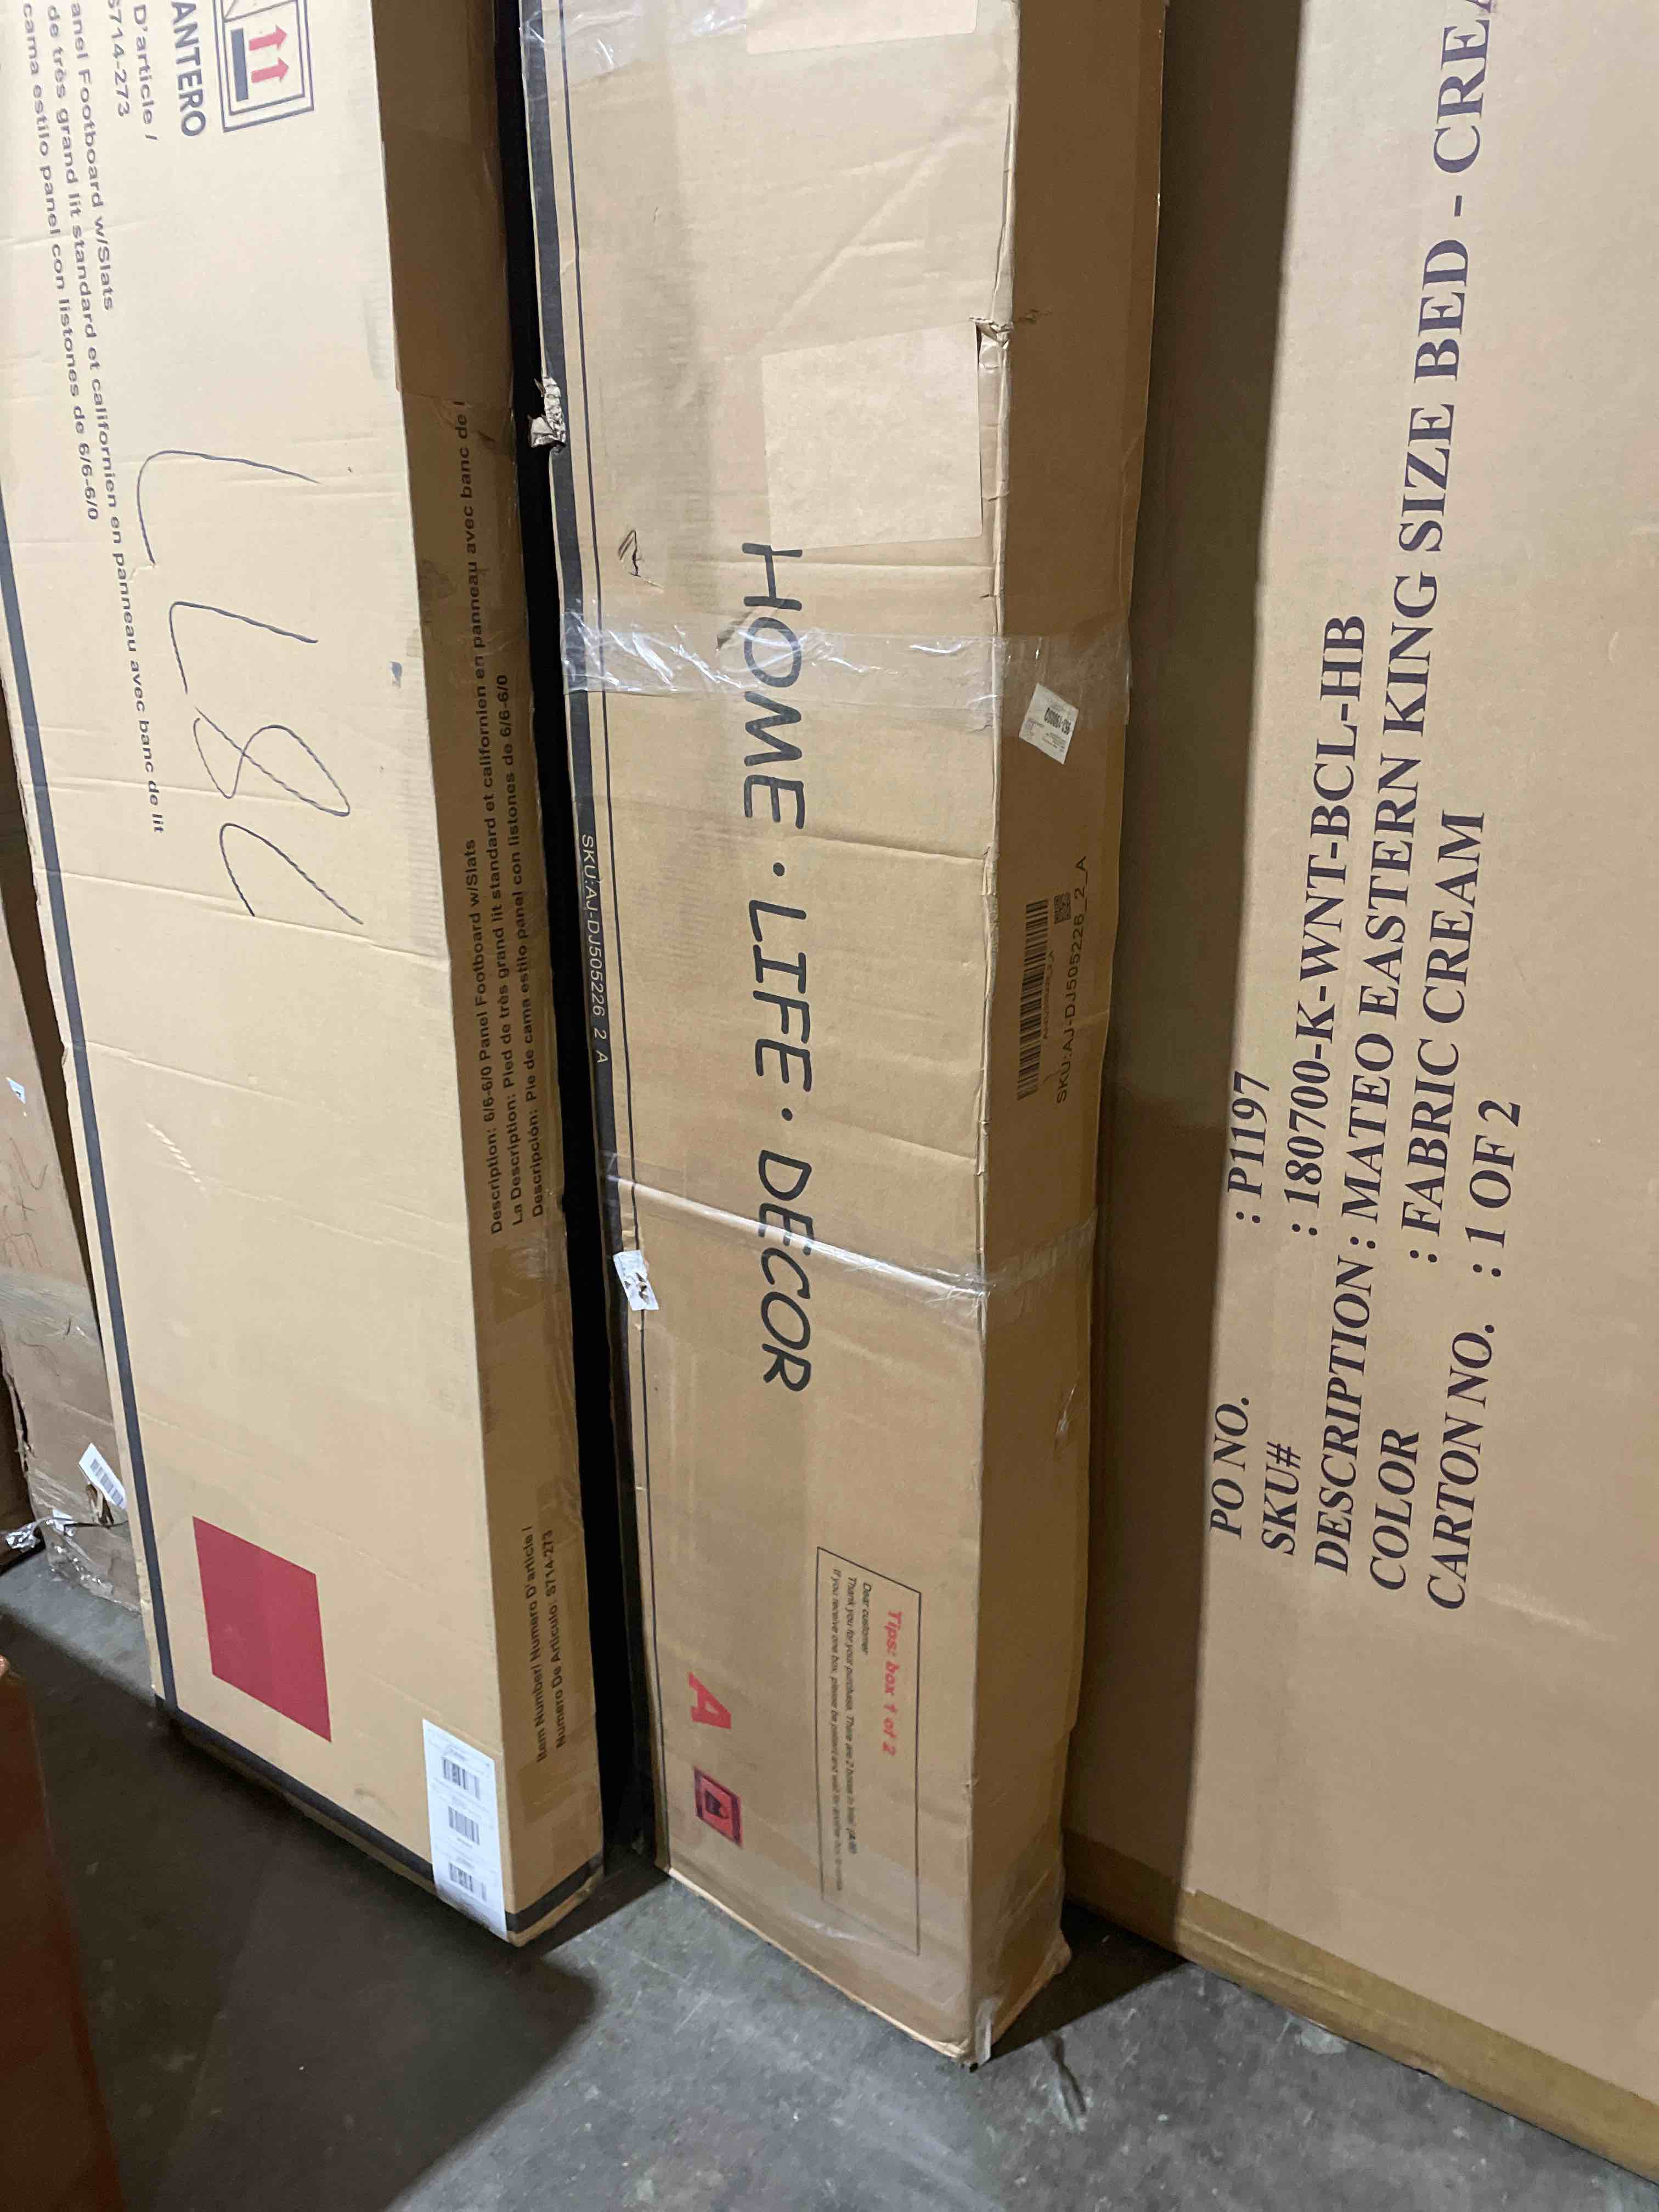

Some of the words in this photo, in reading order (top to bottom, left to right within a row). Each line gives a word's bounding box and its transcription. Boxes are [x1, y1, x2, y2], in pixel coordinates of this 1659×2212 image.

[22, 2, 40, 75] cama
[48, 5, 60, 38] de
[52, 46, 67, 99] très
[171, 1, 206, 137] ANTERO
[1432, 0, 1491, 174] CRE
[32, 84, 50, 156] estilo
[57, 108, 78, 184] grand
[39, 165, 61, 235] panel
[68, 193, 81, 218] lit
[78, 69, 104, 207] Footboard
[93, 216, 114, 311] w/Slats
[52, 244, 65, 290] con
[72, 224, 97, 338] standard
[1413, 238, 1470, 383] BED
[58, 298, 80, 397] listones
[88, 347, 101, 370] et
[73, 405, 86, 434] de
[92, 379, 117, 508] californien
[455, 413, 468, 439] de
[78, 443, 99, 520] 6/6-6/0
[459, 447, 473, 499] banc
[1398, 403, 1455, 553] SIZE
[110, 517, 122, 544] en
[464, 506, 476, 554] avec
[112, 552, 137, 652] panneau
[467, 562, 485, 648] panneau
[475, 655, 486, 679] en
[1383, 571, 1437, 737] KING
[129, 660, 145, 713] avec
[496, 674, 511, 738] 6/6-6/0
[741, 542, 805, 830] HOME
[138, 720, 154, 773] banc
[476, 686, 493, 788] californien
[501, 743, 514, 766] de
[148, 780, 160, 806] de
[483, 793, 494, 812] et
[505, 772, 521, 845] listones
[151, 814, 165, 833] lit
[465, 839, 479, 909] w/Slats
[484, 818, 503, 900] standard
[509, 851, 522, 885] con
[492, 905, 503, 924] lit
[1358, 753, 1421, 1021] EASTERN
[515, 891, 528, 940] panel
[1422, 810, 1485, 1024] CREAM
[470, 912, 487, 1007] Footboard
[495, 927, 510, 979] grand
[517, 945, 529, 994] estilo
[521, 997, 533, 1043] cama
[748, 899, 812, 1093] LIFE
[478, 1010, 493, 1062] Panel
[500, 1023, 512, 1047] de
[523, 1049, 535, 1071] de
[481, 1065, 494, 1123] 6/6-6/0
[501, 1050, 515, 1089] Pied
[526, 1074, 537, 1101] Pie
[1261, 1441, 1301, 1555] SKU#
[1285, 616, 1365, 1209] 180700-K-WNT-BCL-HB
[1227, 1070, 1271, 1198] P1197
[1341, 1033, 1395, 1224] MATEO
[1401, 1038, 1460, 1236] FABRIC
[1479, 1099, 1521, 1127] 2
[503, 1093, 522, 1203] Description:
[1469, 1135, 1516, 1209] OF
[485, 1127, 503, 1234] Description:
[512, 1204, 524, 1225] La
[1465, 1227, 1505, 1248] 1
[758, 1149, 815, 1392] DECOR
[1447, 1324, 1495, 1408] NO.
[1213, 1397, 1250, 1472] NO.
[1314, 1254, 1375, 1575] DESCRIPTION
[1209, 1477, 1244, 1540] PO
[1369, 1427, 1419, 1591] COLOR
[1426, 1413, 1483, 1611] CARTON
[831, 1576, 840, 1596] you
[845, 1577, 857, 1605] Thank
[862, 1582, 872, 1607] Dear
[845, 1606, 854, 1626] you
[845, 1628, 855, 1641] for
[884, 1610, 902, 1656] Tips:
[844, 1642, 853, 1664] your
[885, 1661, 899, 1696] box
[687, 1671, 732, 1730] A
[883, 1704, 898, 1713] 1
[883, 1717, 896, 1738] of
[883, 1742, 896, 1756] 2
